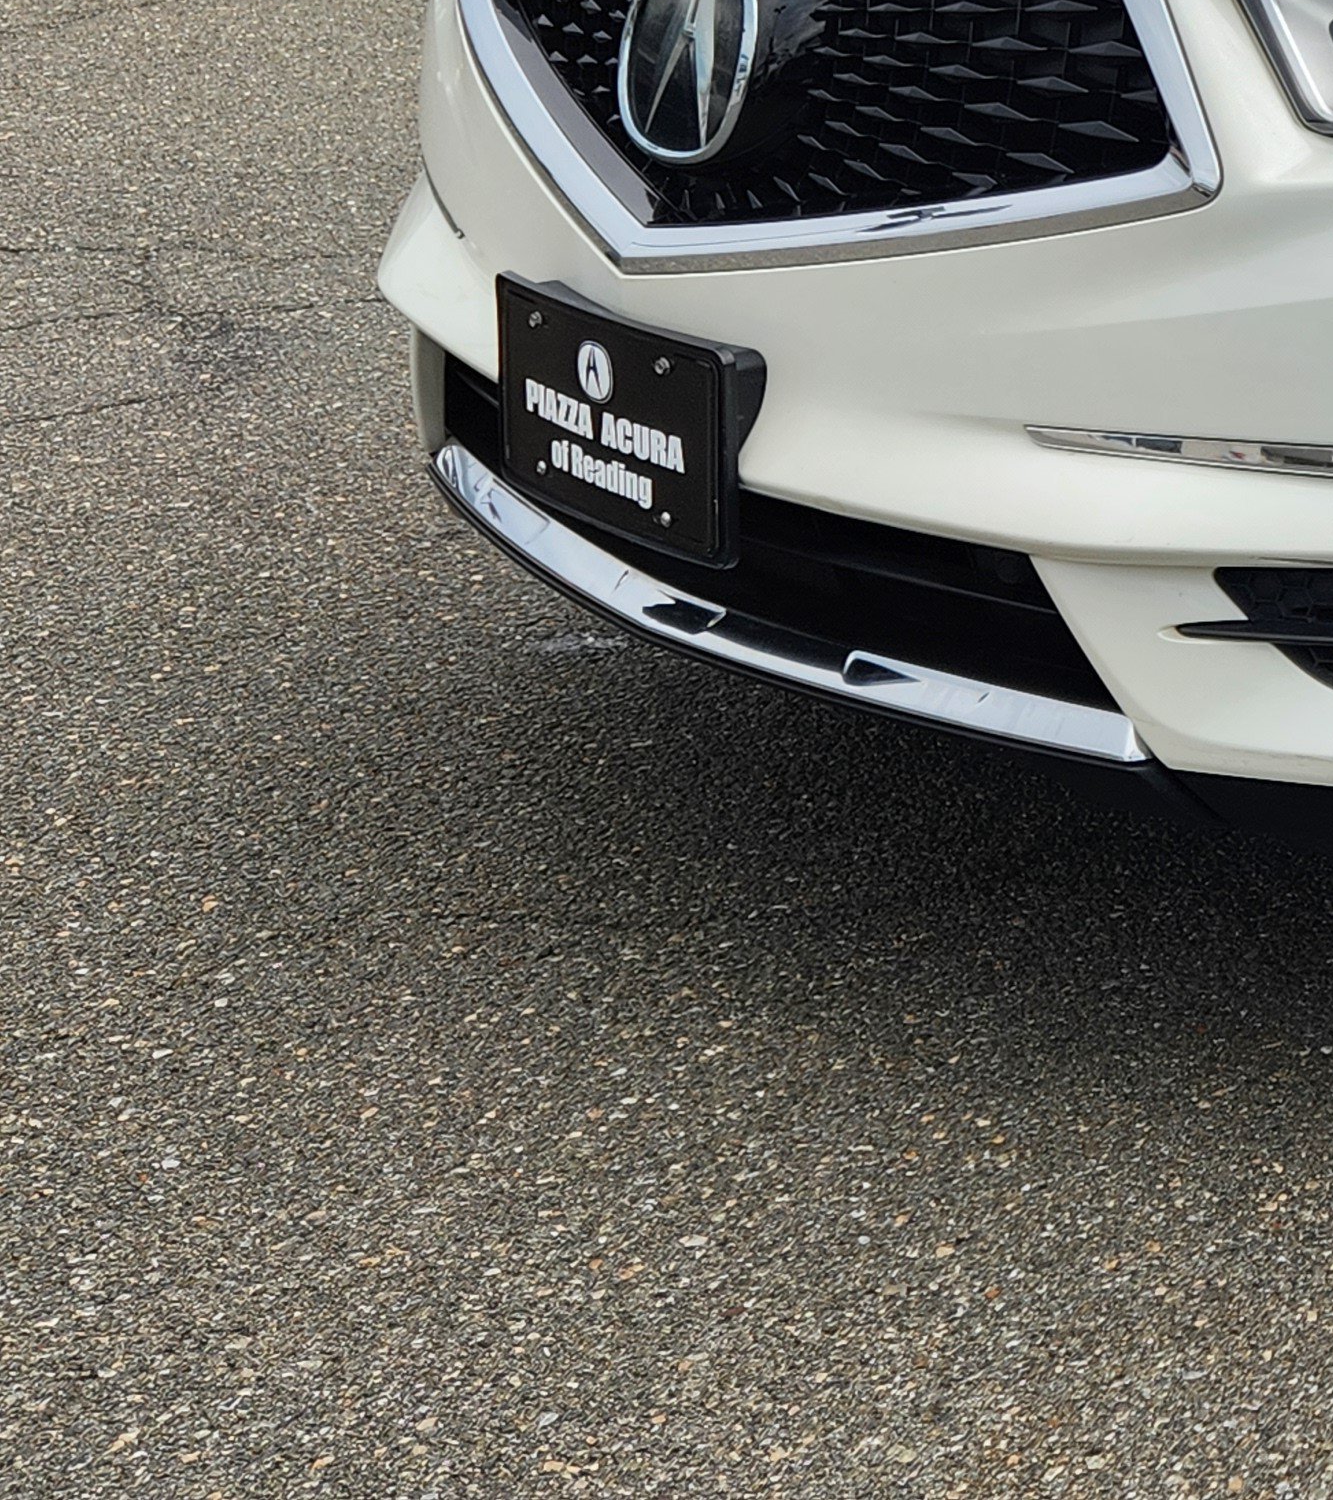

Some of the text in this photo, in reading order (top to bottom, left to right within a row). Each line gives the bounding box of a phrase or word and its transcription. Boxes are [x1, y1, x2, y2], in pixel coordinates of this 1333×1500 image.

[525, 378, 685, 474] PIAZZA ACURA
[551, 440, 653, 510] of Reading
